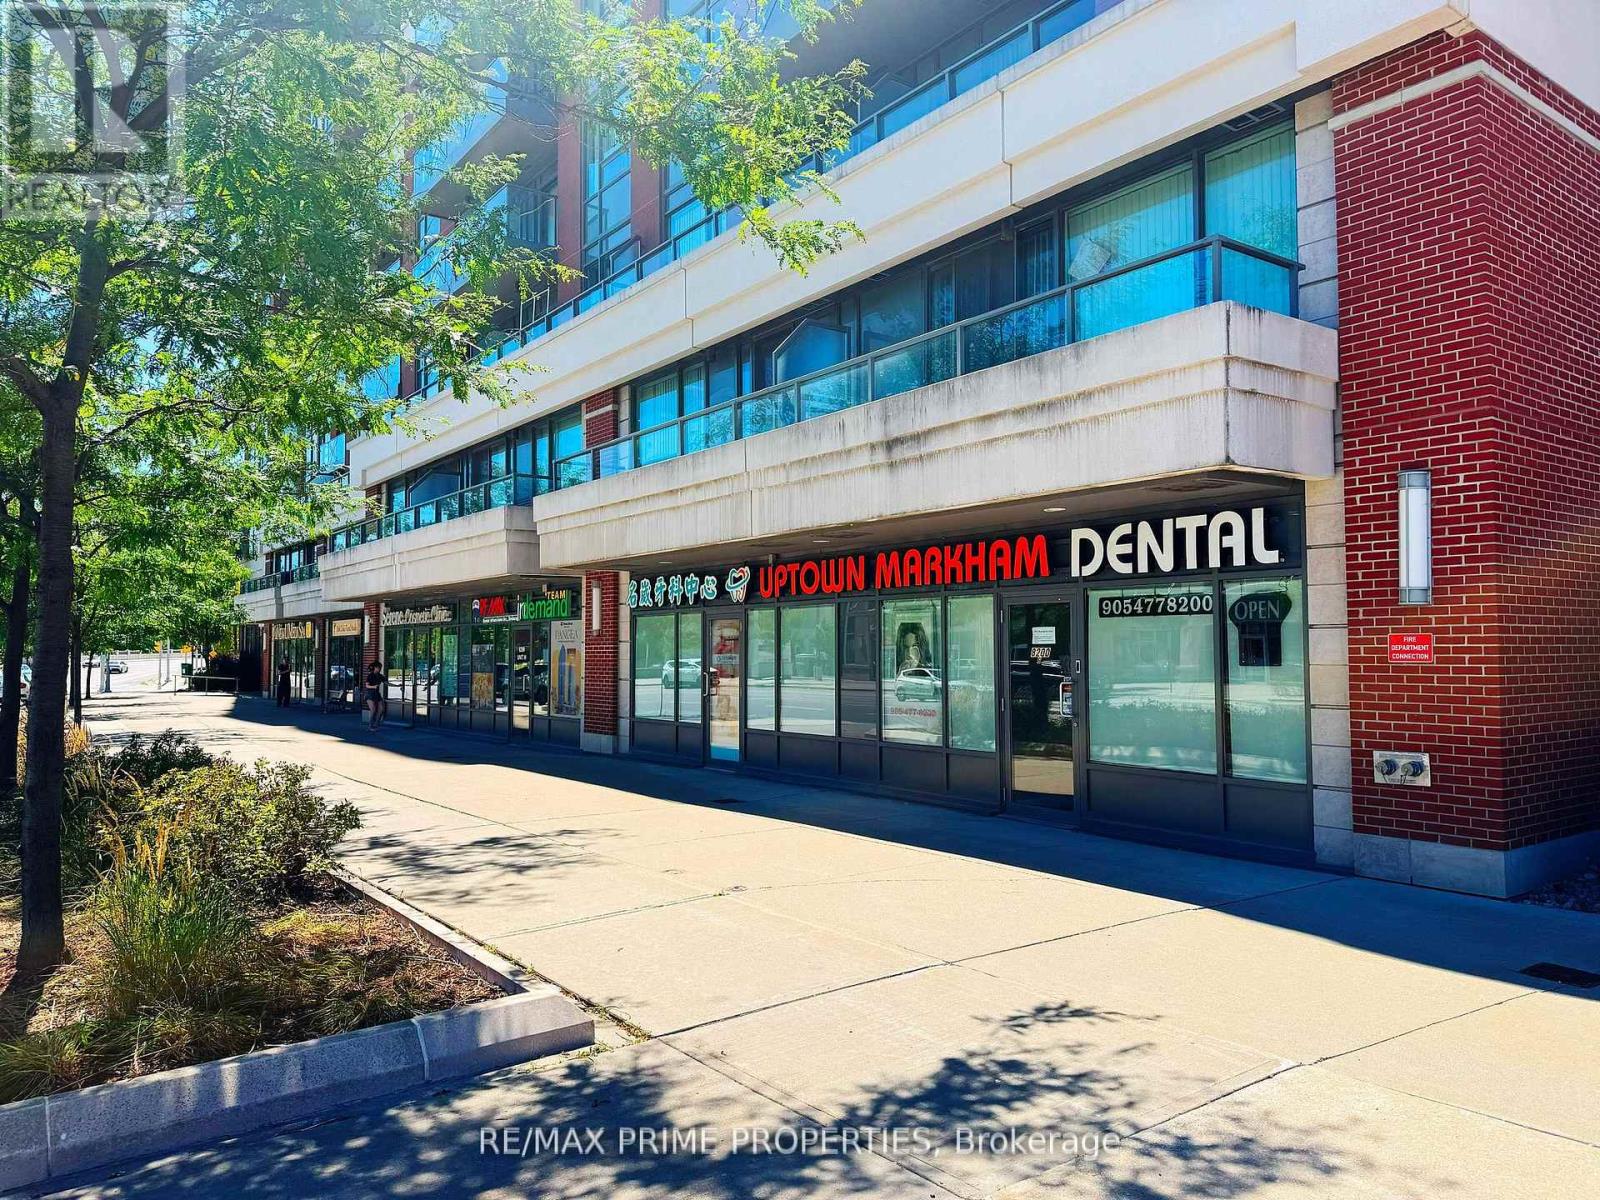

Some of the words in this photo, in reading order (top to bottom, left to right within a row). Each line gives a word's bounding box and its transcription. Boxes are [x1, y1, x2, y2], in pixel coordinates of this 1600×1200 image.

[759, 555, 866, 599] UPTOWN
[875, 533, 1050, 589] MARKHAM
[1071, 507, 1279, 577] DENTAL
[1102, 595, 1213, 615] 9054778200
[1234, 599, 1280, 620] OPEN
